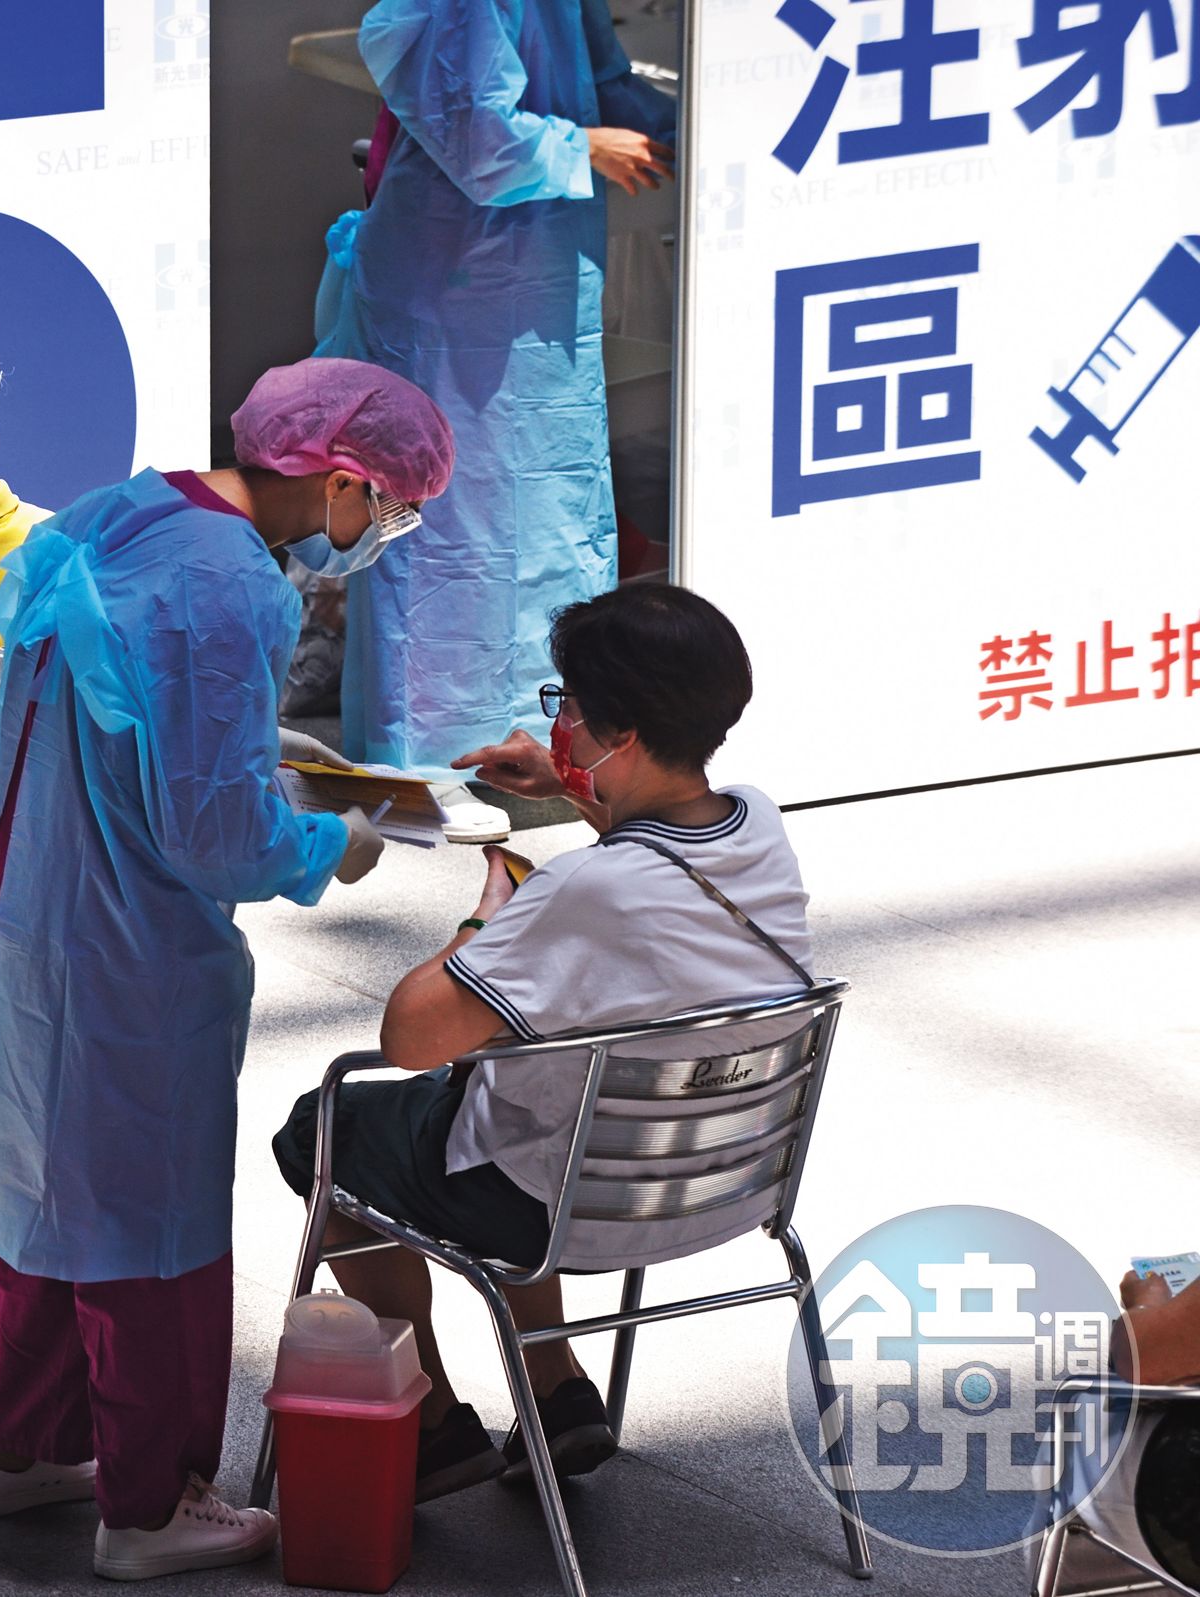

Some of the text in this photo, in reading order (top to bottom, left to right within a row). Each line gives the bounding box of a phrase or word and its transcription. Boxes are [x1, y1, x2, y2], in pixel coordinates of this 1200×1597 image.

[36, 143, 110, 176] SAFE
[772, 242, 981, 518] 區
[680, 1058, 754, 1090] Leader
